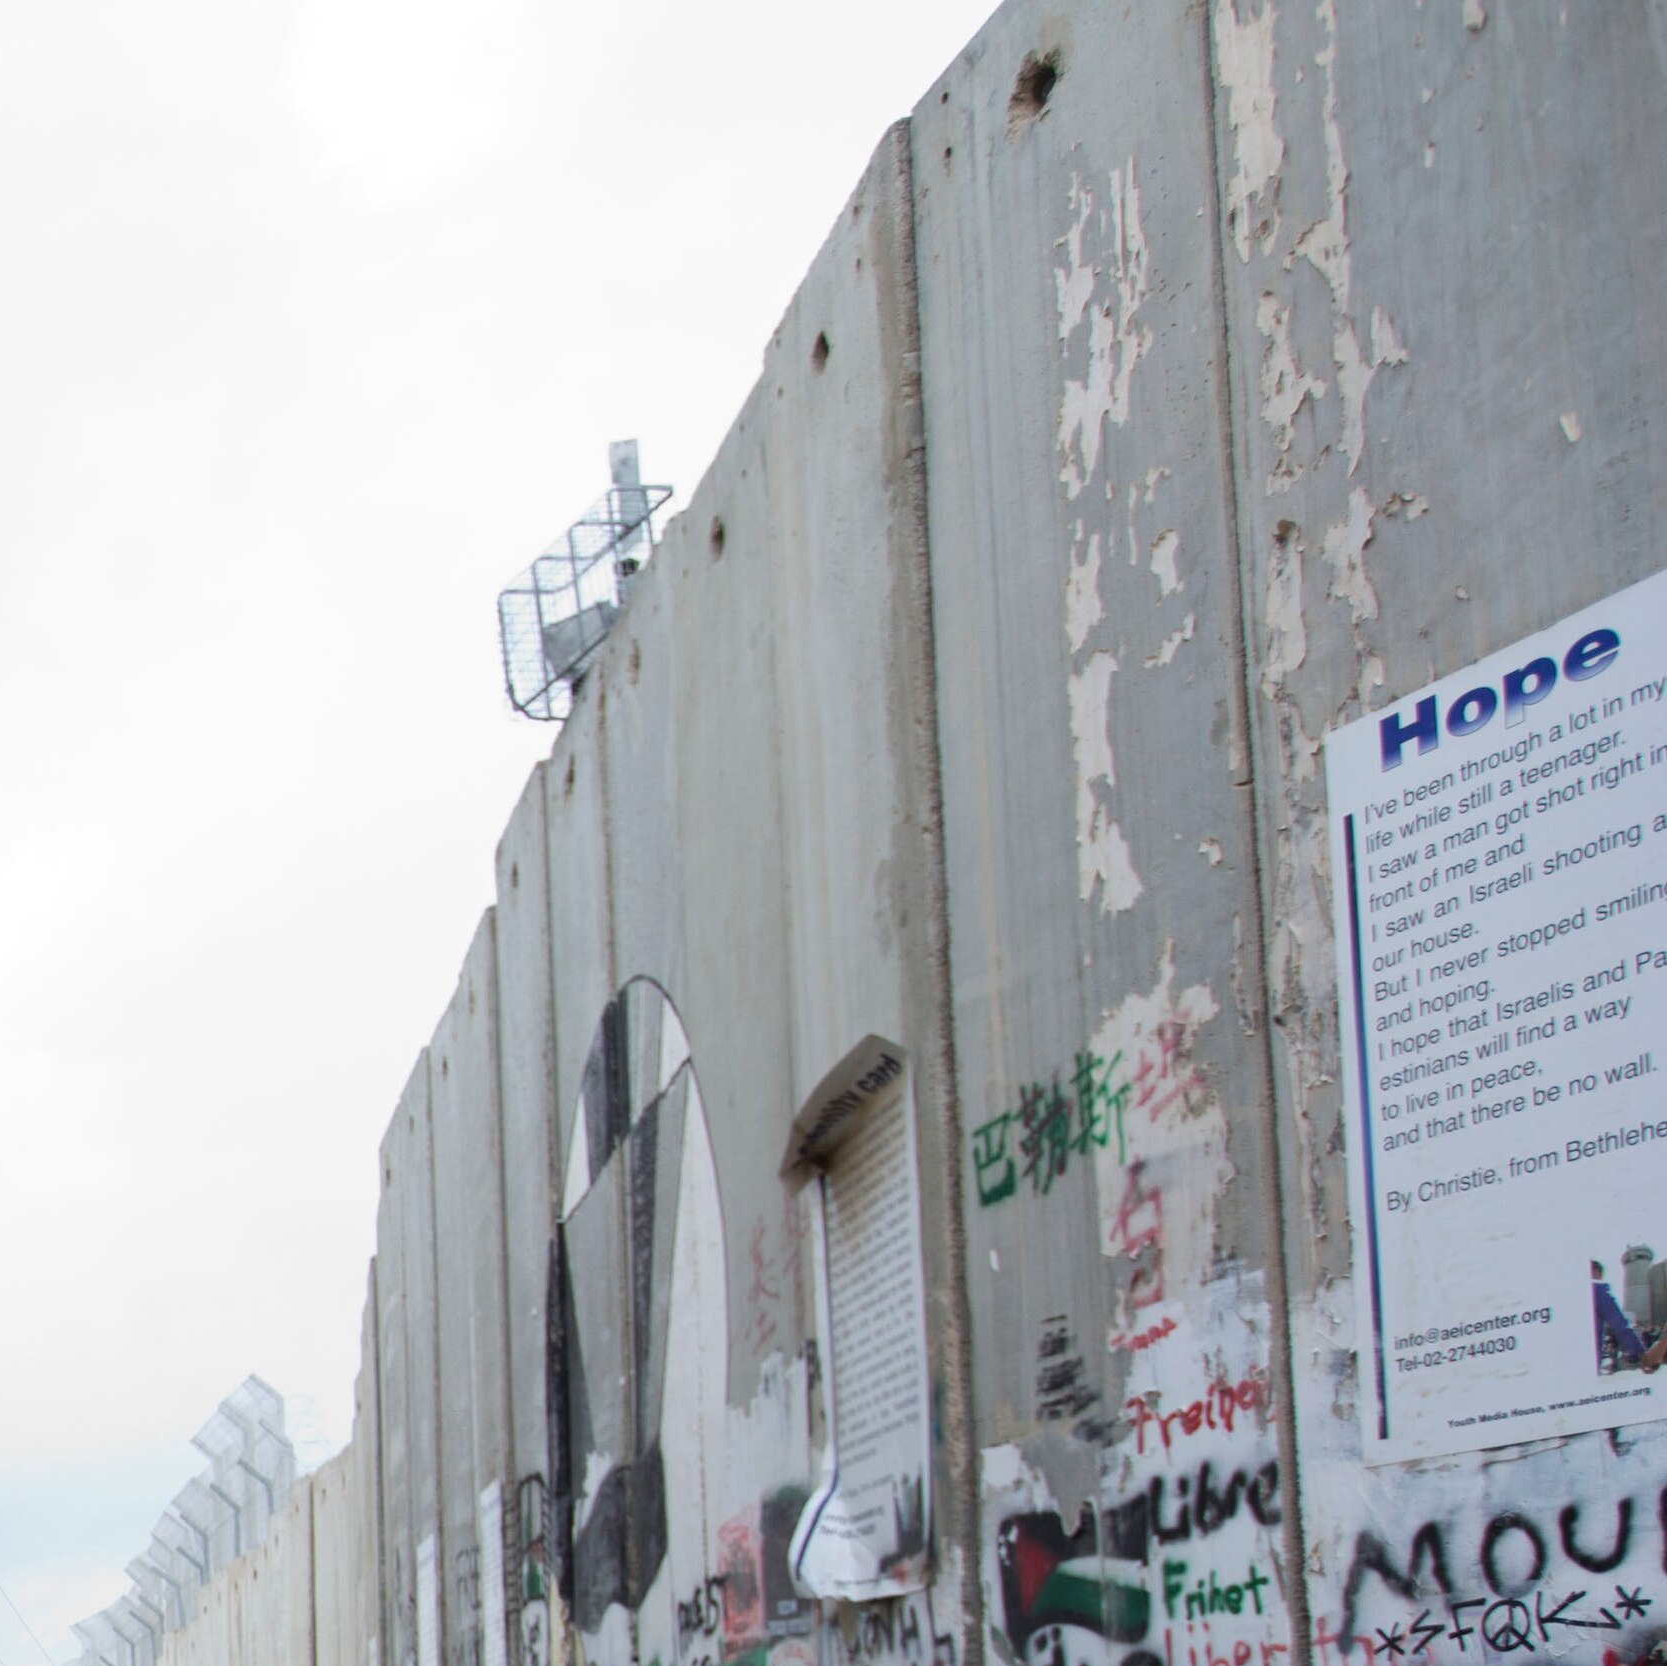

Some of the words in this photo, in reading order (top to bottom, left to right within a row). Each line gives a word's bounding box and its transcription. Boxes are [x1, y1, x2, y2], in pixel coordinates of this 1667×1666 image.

[1379, 628, 1622, 773] Hope
[1364, 800, 1398, 825] I've
[1403, 773, 1455, 808] been
[1459, 731, 1542, 783] through
[1548, 724, 1563, 742] a
[1569, 704, 1597, 733] lot
[1602, 697, 1624, 718] in
[1630, 676, 1667, 707] my
[1365, 829, 1393, 854] life
[1398, 802, 1451, 839] while
[1458, 781, 1493, 815] still
[1499, 777, 1514, 796] a
[1519, 729, 1627, 789] teenager.
[1379, 851, 1419, 879] saw
[1424, 843, 1438, 860] a
[1443, 820, 1489, 852] man
[1494, 801, 1530, 836] got
[1535, 778, 1585, 813] shot
[1590, 753, 1645, 792] right
[1368, 881, 1416, 914] front
[1418, 869, 1445, 893] of
[1445, 858, 1478, 883] me
[1484, 833, 1526, 866] and
[1385, 908, 1427, 937] saw
[1433, 896, 1460, 918] an
[1469, 862, 1535, 904] Israeli
[1542, 823, 1643, 876] shooting
[1372, 948, 1406, 972] our
[1410, 922, 1480, 959] house.
[1374, 975, 1409, 1002] But
[1429, 947, 1489, 982] never
[1496, 907, 1587, 959] stopped
[1595, 881, 1667, 922] smilin
[1375, 1004, 1413, 1032] and
[1418, 979, 1496, 1017] hoping.
[1379, 1049, 1469, 1092] estinians
[1475, 1032, 1510, 1060] will
[1514, 1016, 1556, 1047] find
[1563, 1014, 1578, 1032] a
[1584, 996, 1633, 1025] way
[1390, 1028, 1441, 1057] hope
[1447, 1008, 1489, 1039] that
[1495, 980, 1575, 1022] Israelis
[1581, 960, 1626, 992] and
[1380, 1102, 1400, 1121] to
[1405, 1090, 1440, 1116] live
[1445, 1082, 1465, 1101] in
[1470, 1059, 1544, 1098] peace,
[1382, 1124, 1421, 1151] and
[1426, 1110, 1465, 1139] that
[1470, 1095, 1526, 1125] there
[1532, 1085, 1561, 1107] be
[1568, 1073, 1597, 1096] no
[1603, 1052, 1658, 1085] wall.
[1386, 1190, 1413, 1213] By
[1417, 1167, 1503, 1203] Christie,
[1508, 1150, 1560, 1179] from
[1393, 1306, 1552, 1350] info@aeicenter.org
[1394, 1336, 1517, 1373] Tel-02-2744030
[1447, 1416, 1477, 1429] Youth
[1478, 1411, 1509, 1424] Media
[1510, 1405, 1547, 1418] House,
[1163, 1558, 1270, 1621] Frihet
